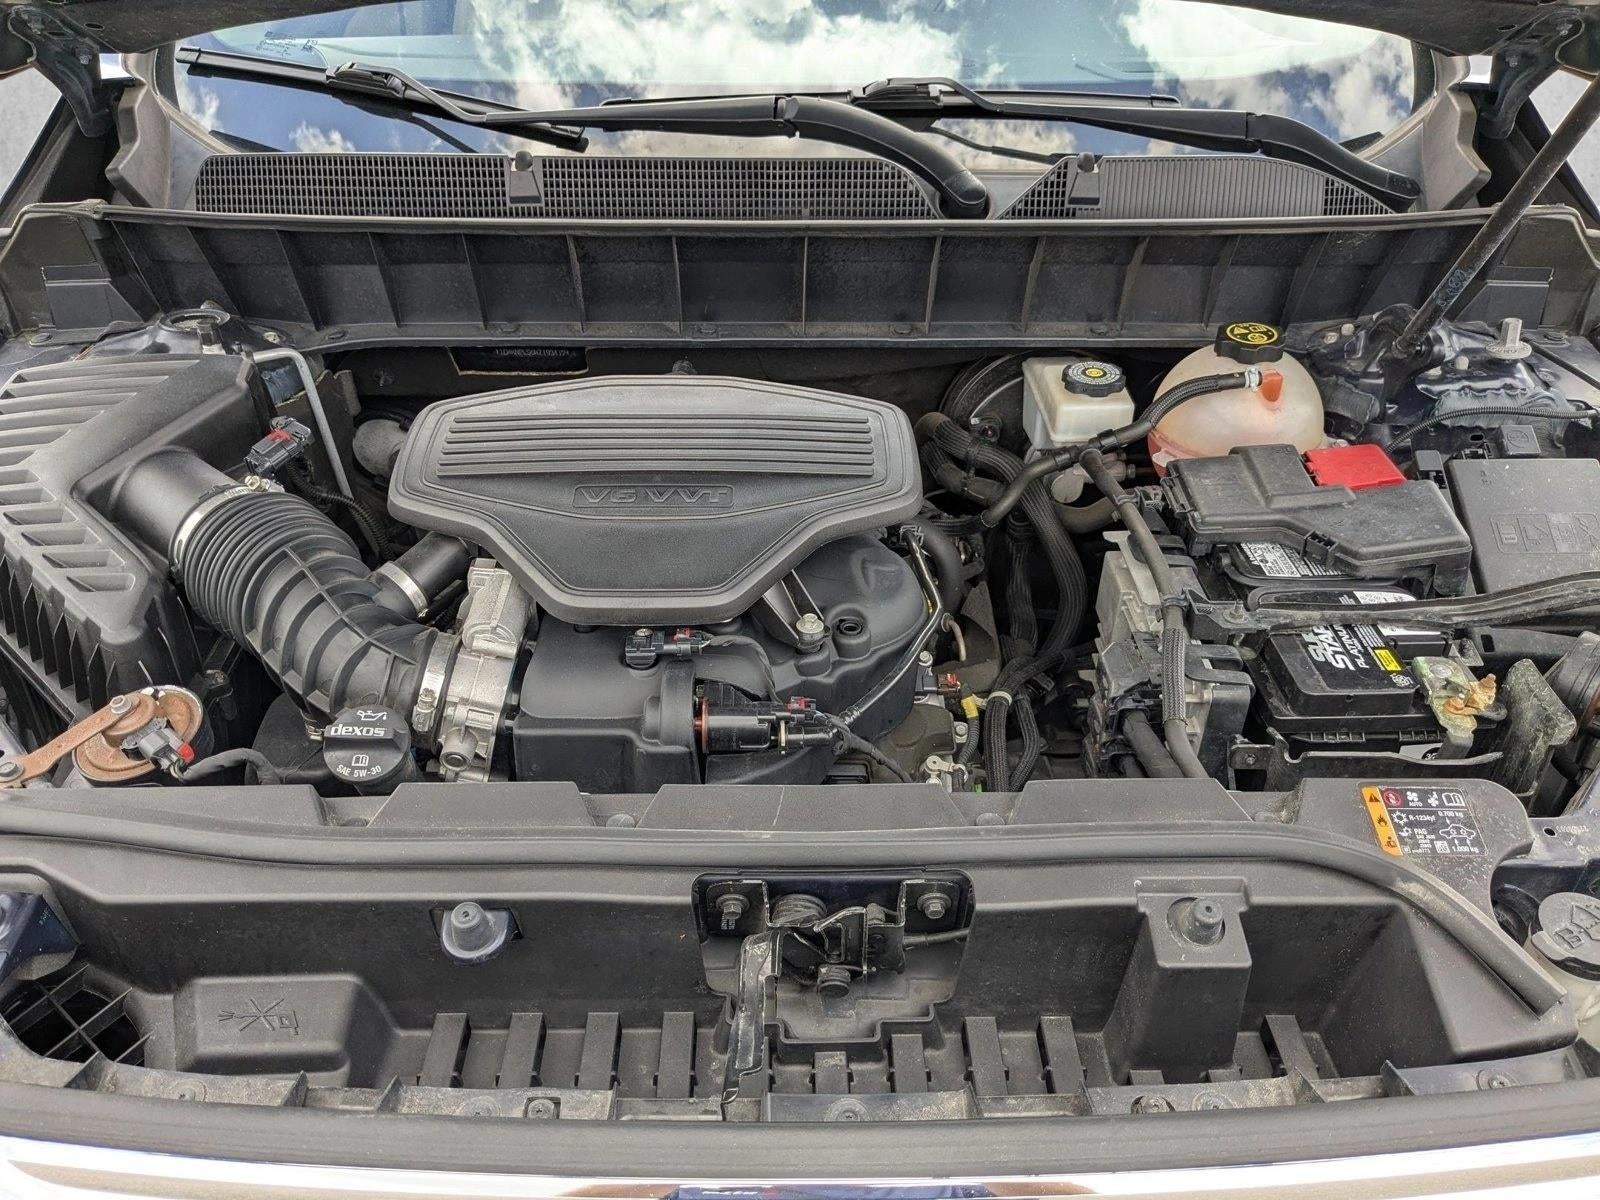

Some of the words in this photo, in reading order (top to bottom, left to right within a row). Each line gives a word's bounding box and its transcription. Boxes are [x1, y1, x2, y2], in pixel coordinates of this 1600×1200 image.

[581, 488, 636, 503] V6
[643, 488, 728, 503] VVT
[331, 724, 385, 737] dexos
[336, 764, 351, 776] SAE
[353, 765, 382, 778] 5W-30
